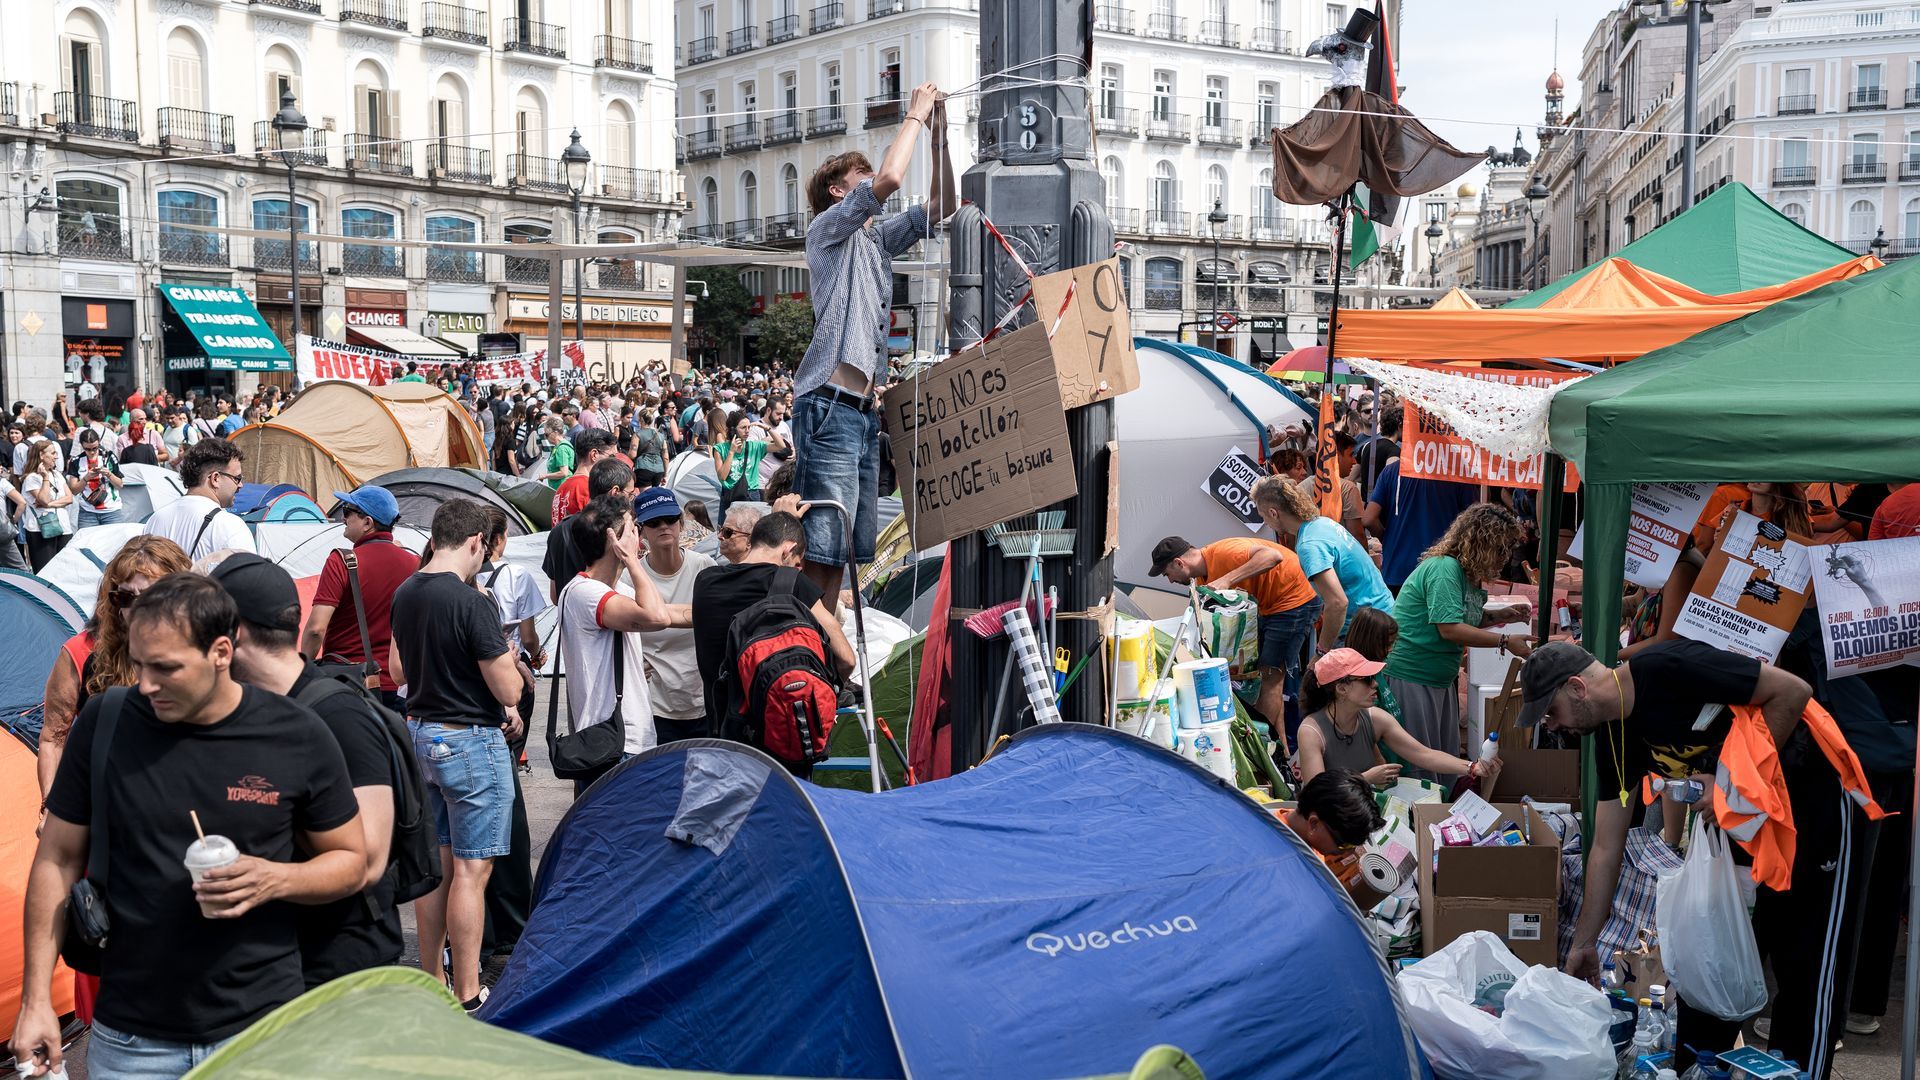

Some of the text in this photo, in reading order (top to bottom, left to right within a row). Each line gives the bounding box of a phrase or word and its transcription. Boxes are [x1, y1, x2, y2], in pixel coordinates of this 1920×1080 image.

[169, 287, 243, 303] CHANGE
[1092, 263, 1124, 313] O
[185, 313, 258, 326] TRANSFER
[347, 312, 400, 325] CHANGE
[542, 304, 578, 319] CSA
[591, 306, 609, 321] DE
[617, 307, 659, 322] DIEGO
[203, 335, 275, 349] CAMBIO
[1087, 325, 1112, 373] Y
[168, 357, 205, 370] CHANGE
[241, 360, 268, 369] CHANGE
[900, 366, 1007, 433] Esto NO es
[937, 404, 1020, 458] botellón
[1413, 440, 1482, 479] CONTRA
[1487, 450, 1509, 482] LA
[915, 444, 1054, 514] RECOGE tu basura
[1669, 482, 1701, 501] CONTRATO
[1218, 482, 1257, 516] STOP
[1635, 493, 1670, 513] COMUNIDAD
[1630, 514, 1680, 545] NOS ROBA
[1687, 605, 1750, 636] LAVAPIÉS HABLEN
[1691, 597, 1768, 635] QUE LAS VENTANAS DE
[1828, 601, 1920, 624] 5 ABRIL 12:00 H ATOCH
[1830, 613, 1920, 641] BAJEMOS LO
[1834, 630, 1920, 660] ALQUILERE
[1026, 915, 1198, 957] Quechua
